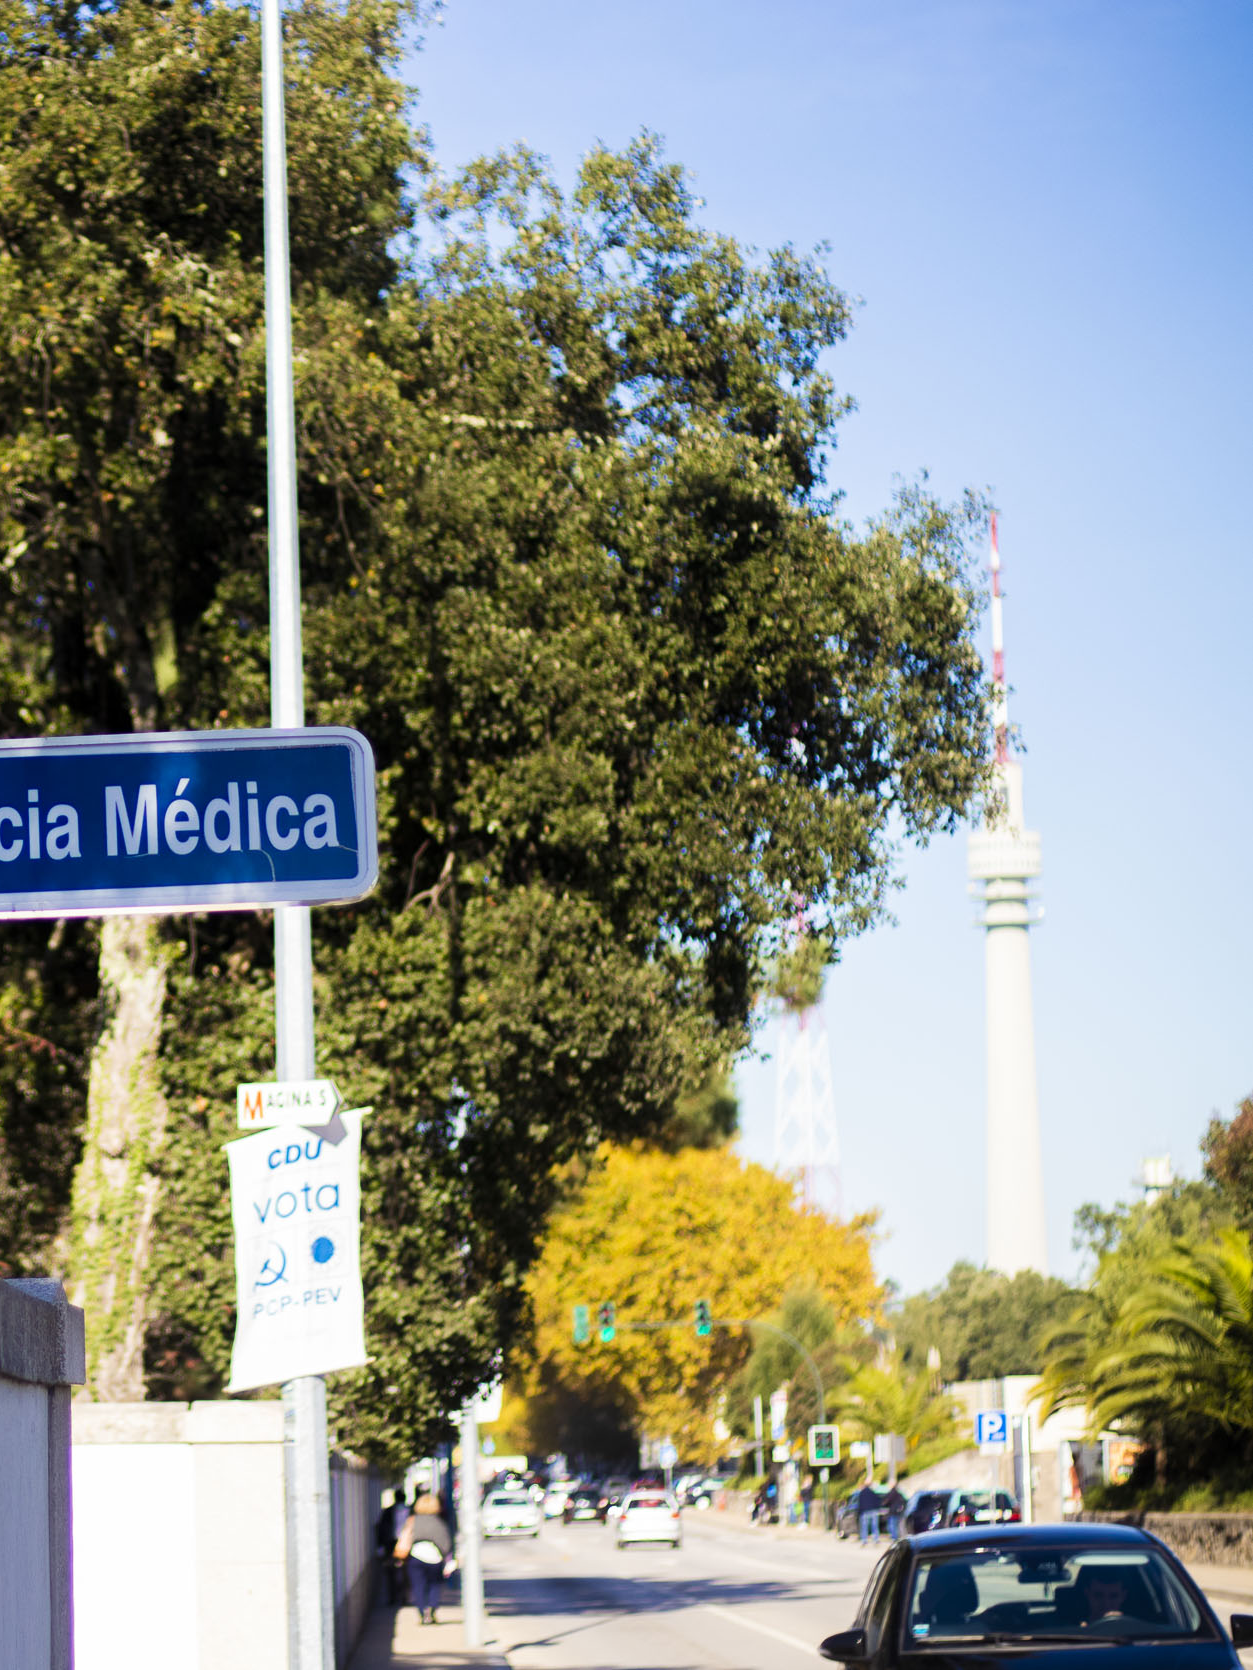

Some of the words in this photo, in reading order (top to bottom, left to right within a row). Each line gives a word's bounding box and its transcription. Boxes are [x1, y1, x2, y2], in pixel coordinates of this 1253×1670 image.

[105, 778, 340, 857] Médica
[268, 1137, 325, 1170] CDU
[253, 1181, 340, 1224] vota
[252, 1285, 342, 1320] PCP-PEV
